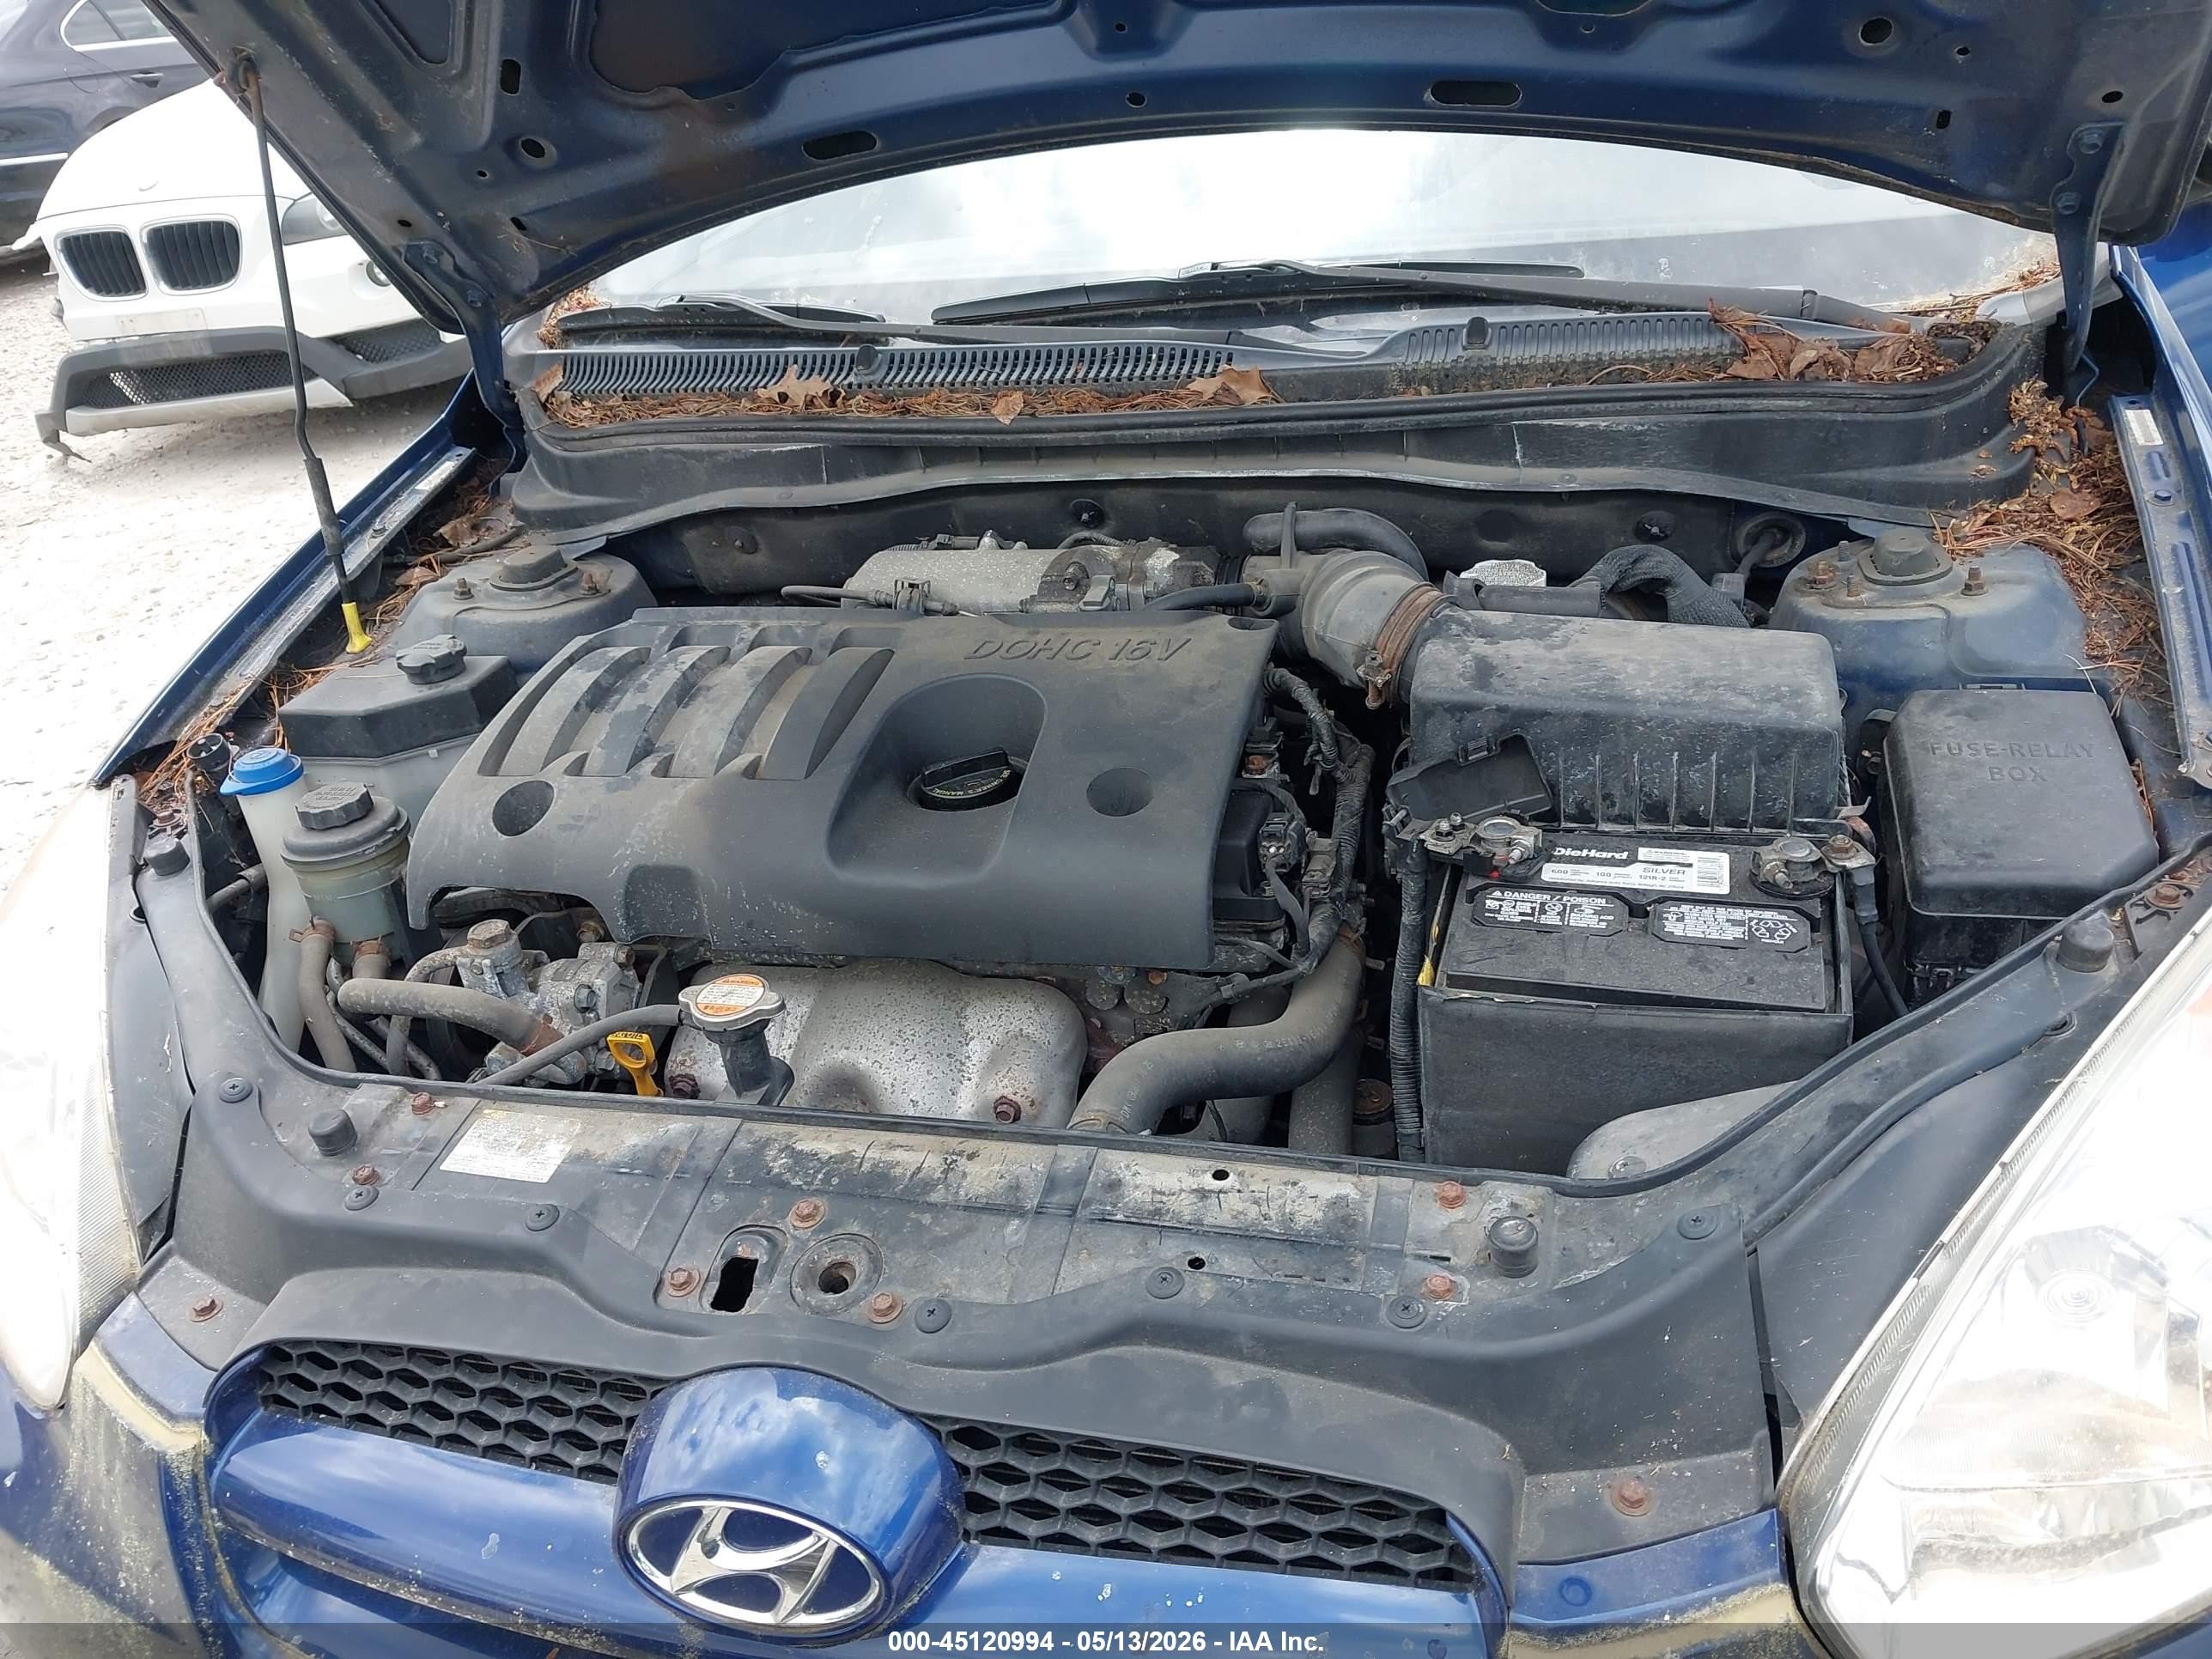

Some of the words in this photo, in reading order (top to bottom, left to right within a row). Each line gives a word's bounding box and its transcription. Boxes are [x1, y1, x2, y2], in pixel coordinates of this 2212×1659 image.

[963, 638, 1101, 660] DOHC
[1109, 637, 1192, 661] 16V
[1929, 741, 2095, 758] FUSE-RELAY
[1989, 766, 2048, 782] BOX
[968, 778, 1003, 793] OWNER'S
[1553, 848, 1629, 860] DieHard
[1642, 866, 1686, 876] SILVER
[1504, 891, 1551, 900] DANGER
